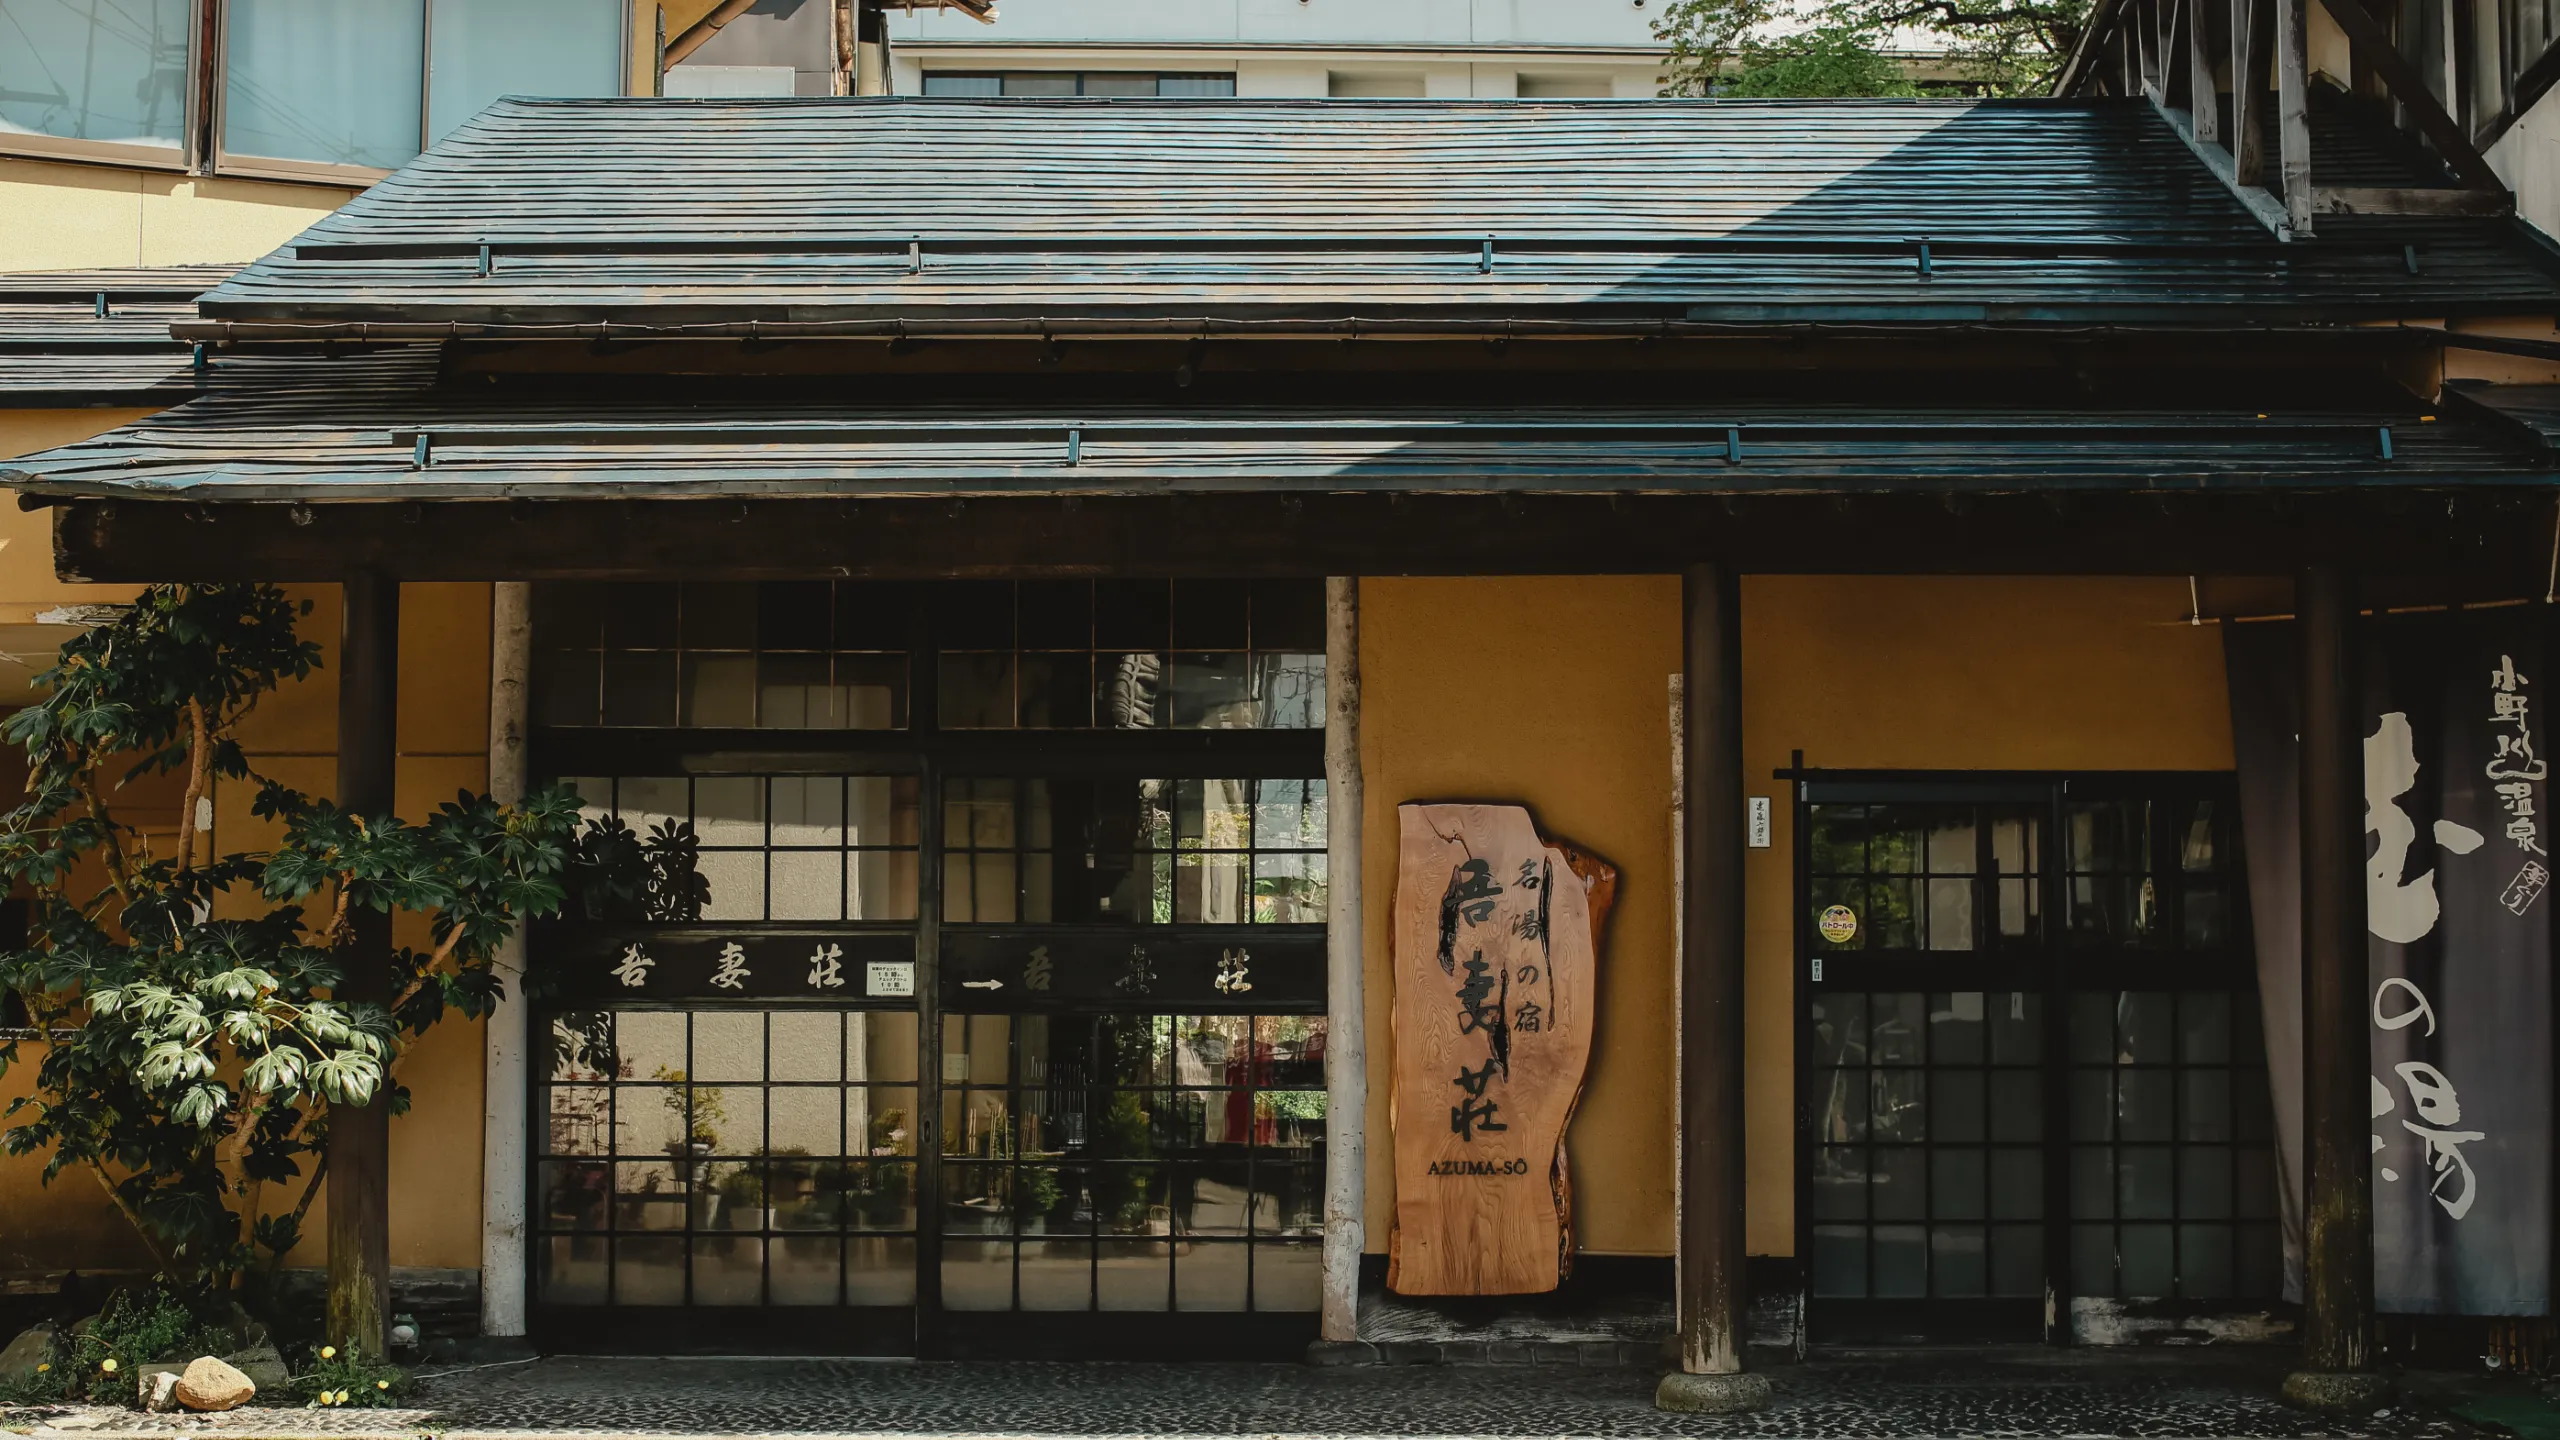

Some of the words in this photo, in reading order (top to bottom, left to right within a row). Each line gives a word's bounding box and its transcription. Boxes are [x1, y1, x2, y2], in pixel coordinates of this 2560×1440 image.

[2486, 654, 2548, 857] 小野川温泉
[611, 942, 846, 990] 吾妻荘
[1443, 858, 1508, 1142] 吾妻荘
[1511, 857, 1541, 1034] 名湯の宿
[1822, 922, 1854, 930] パトロール中
